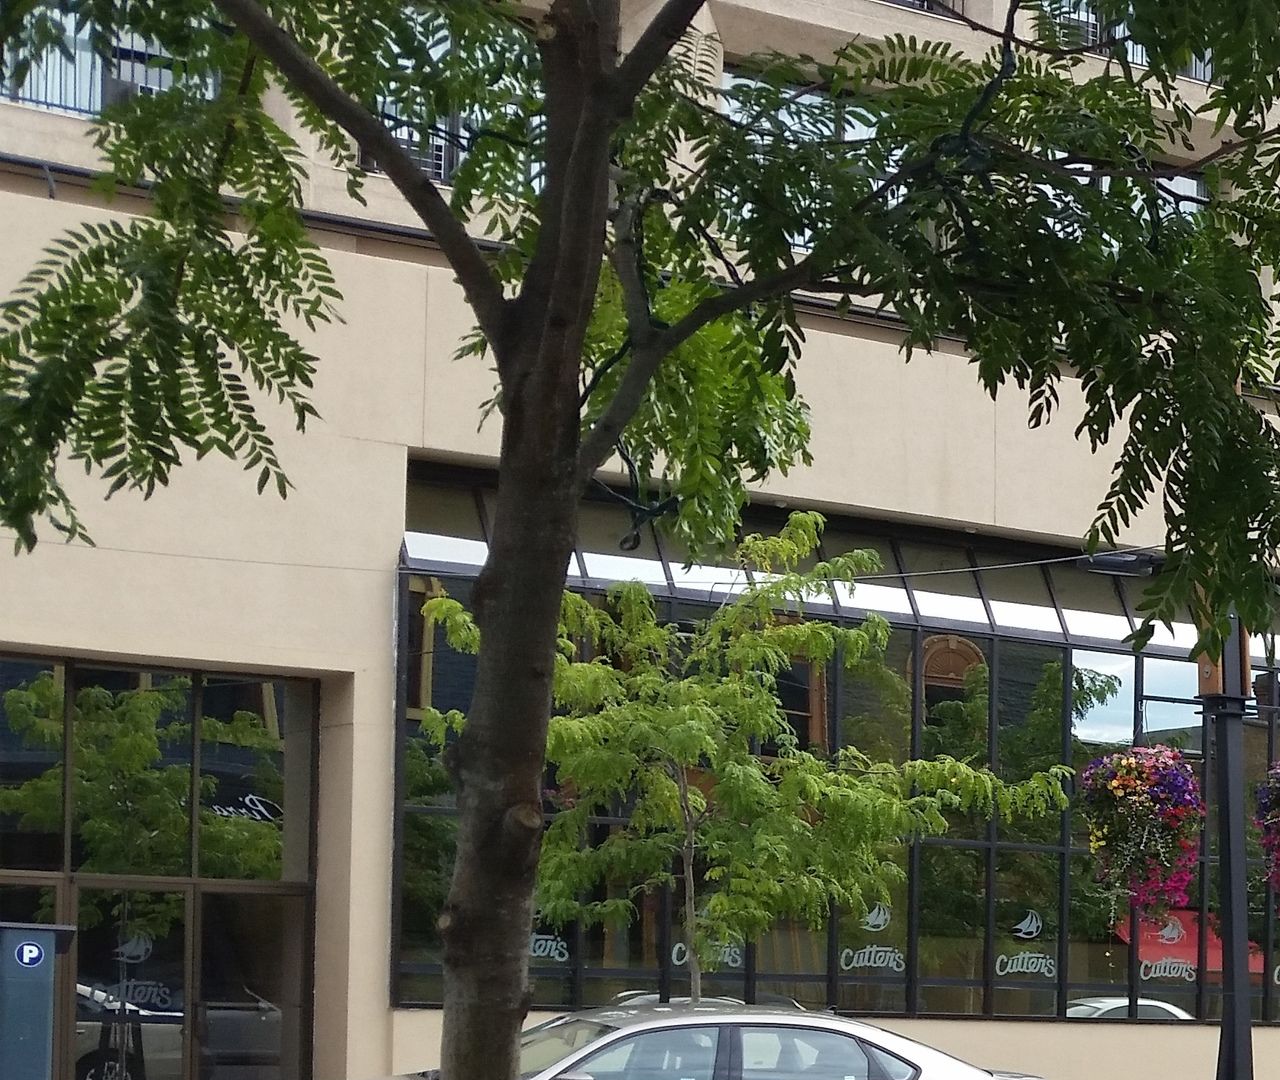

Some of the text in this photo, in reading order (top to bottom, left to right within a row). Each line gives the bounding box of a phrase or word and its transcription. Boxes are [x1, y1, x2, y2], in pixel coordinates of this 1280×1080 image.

[22, 945, 39, 963] P
[840, 944, 906, 972] Cutter's
[995, 951, 1056, 978] Cutter's
[1139, 957, 1197, 982] Cutter's
